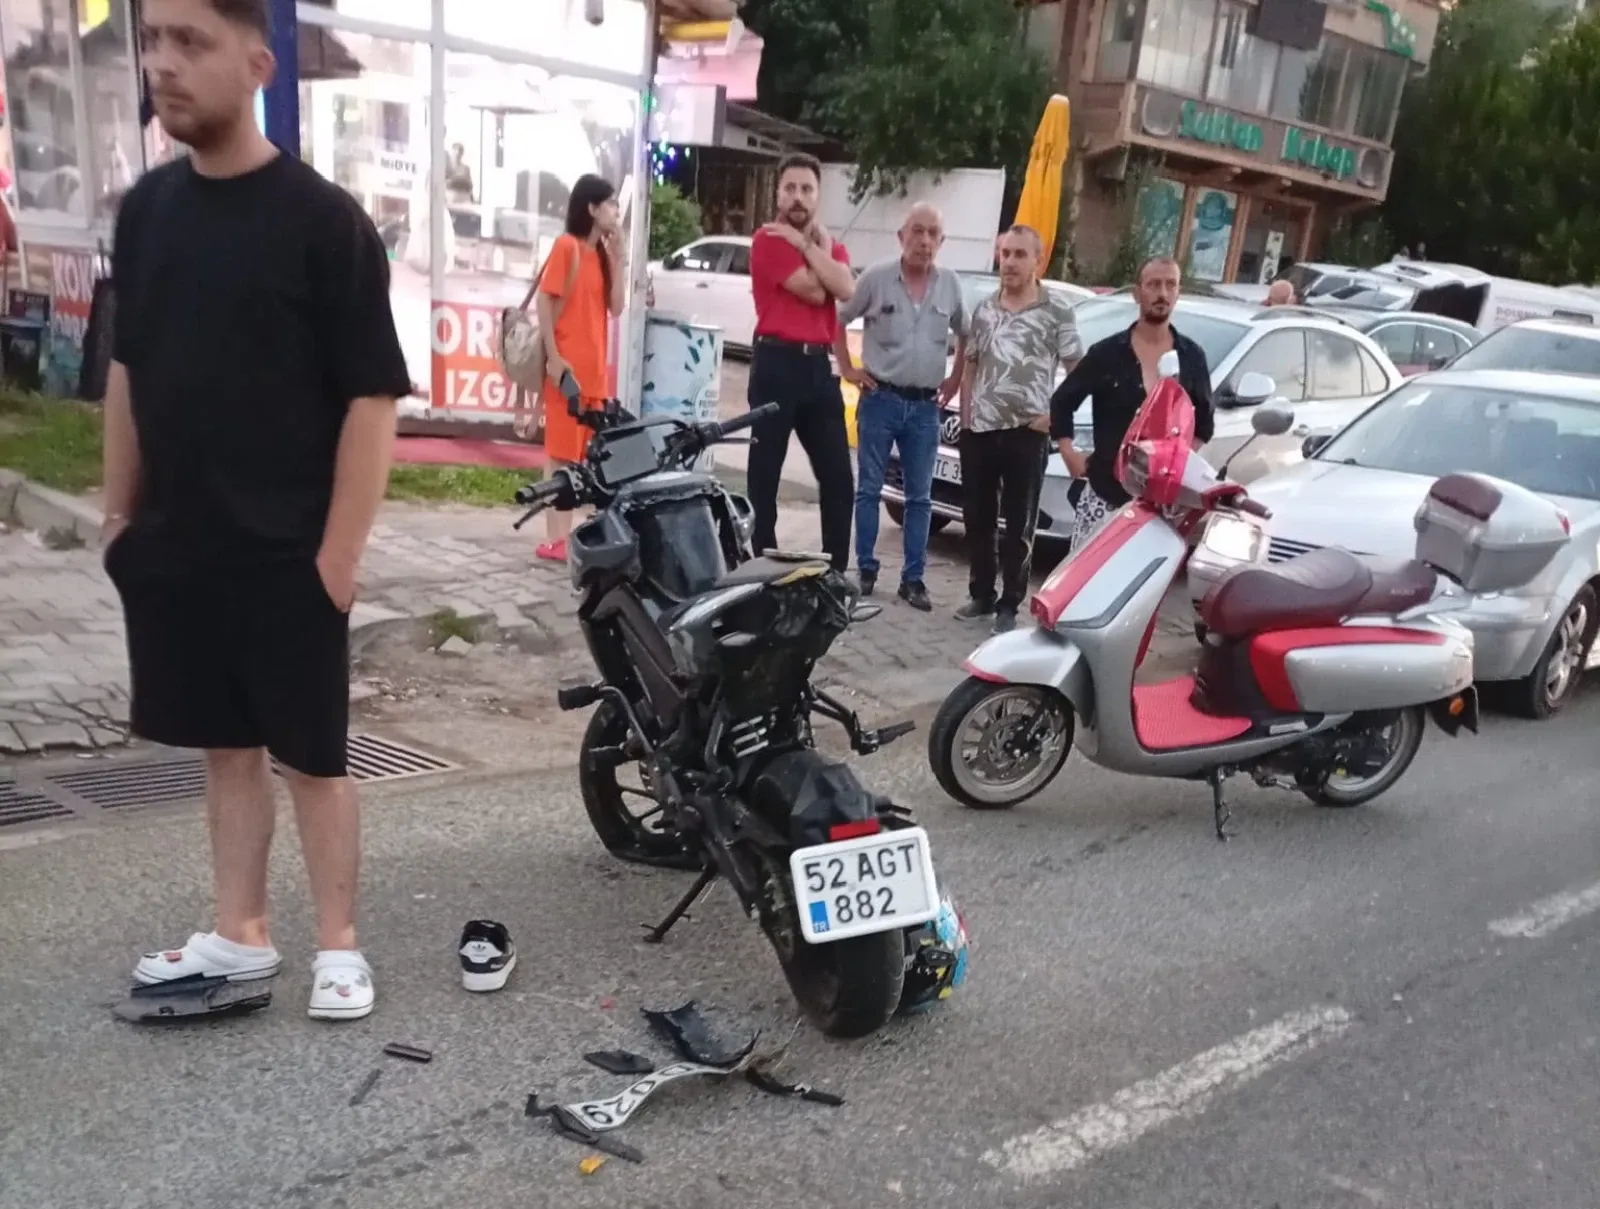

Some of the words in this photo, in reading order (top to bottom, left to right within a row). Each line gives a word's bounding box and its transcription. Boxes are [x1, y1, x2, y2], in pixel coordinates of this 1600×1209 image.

[804, 858, 847, 892] 52
[857, 844, 915, 881] AGT
[835, 887, 896, 923] 882
